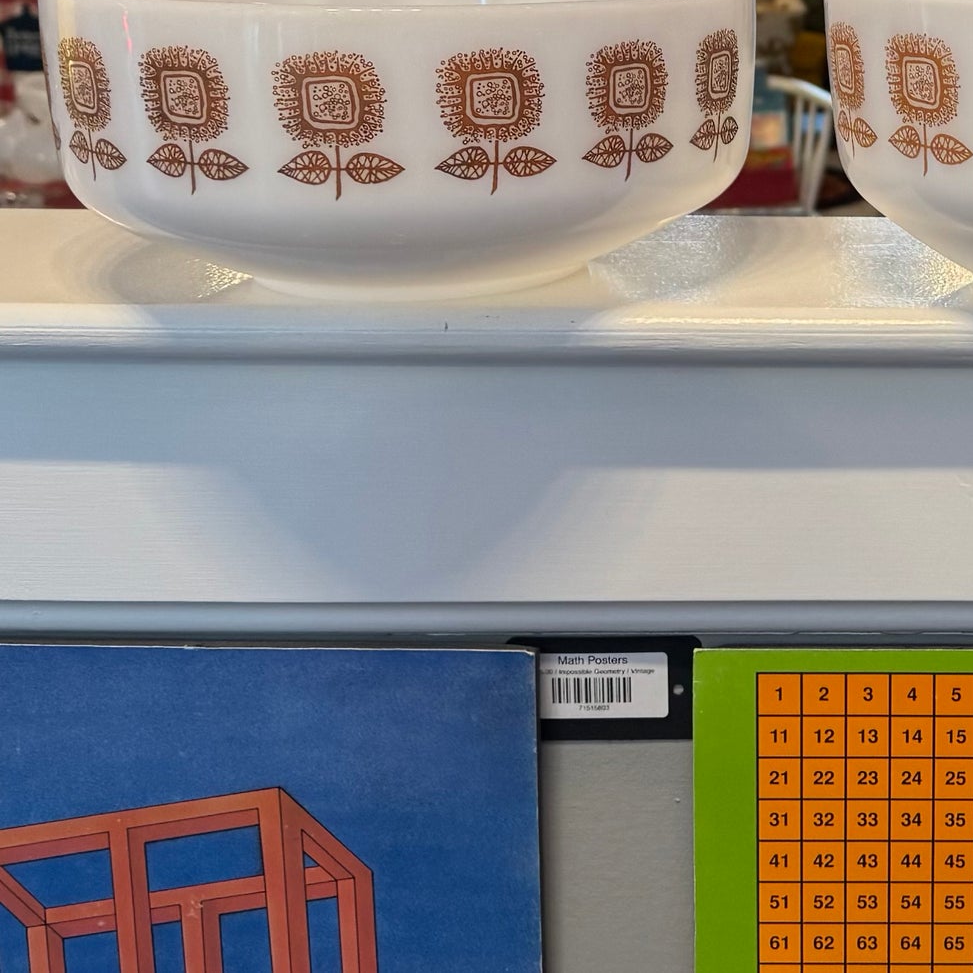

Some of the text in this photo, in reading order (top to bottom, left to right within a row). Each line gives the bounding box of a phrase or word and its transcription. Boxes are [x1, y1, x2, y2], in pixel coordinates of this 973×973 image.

[558, 655, 628, 665] Math Posters
[594, 668, 626, 676] Geometry
[630, 668, 655, 676] Vintage
[776, 687, 782, 700] 1
[819, 687, 828, 701] 2
[864, 687, 873, 701] 3
[907, 688, 917, 701] 4
[952, 688, 961, 701] 5
[770, 729, 787, 743] 11
[815, 729, 834, 743] 12
[858, 729, 878, 743] 13
[903, 730, 922, 743] 14
[947, 730, 966, 743] 15
[770, 771, 787, 784] 21
[814, 771, 834, 785] 22
[858, 771, 878, 785] 23
[902, 771, 922, 785] 24
[946, 771, 965, 785] 25
[770, 813, 787, 826] 31
[814, 813, 834, 826] 32
[858, 813, 878, 826] 33
[901, 813, 921, 826] 34
[945, 813, 965, 827] 35
[770, 854, 787, 867] 41
[814, 854, 834, 867] 42
[857, 854, 877, 868] 43
[901, 854, 921, 867] 44
[945, 855, 965, 868] 45
[770, 895, 787, 909] 51
[814, 895, 834, 909] 52
[858, 895, 877, 909] 53
[901, 896, 921, 909] 54
[945, 896, 964, 909] 55
